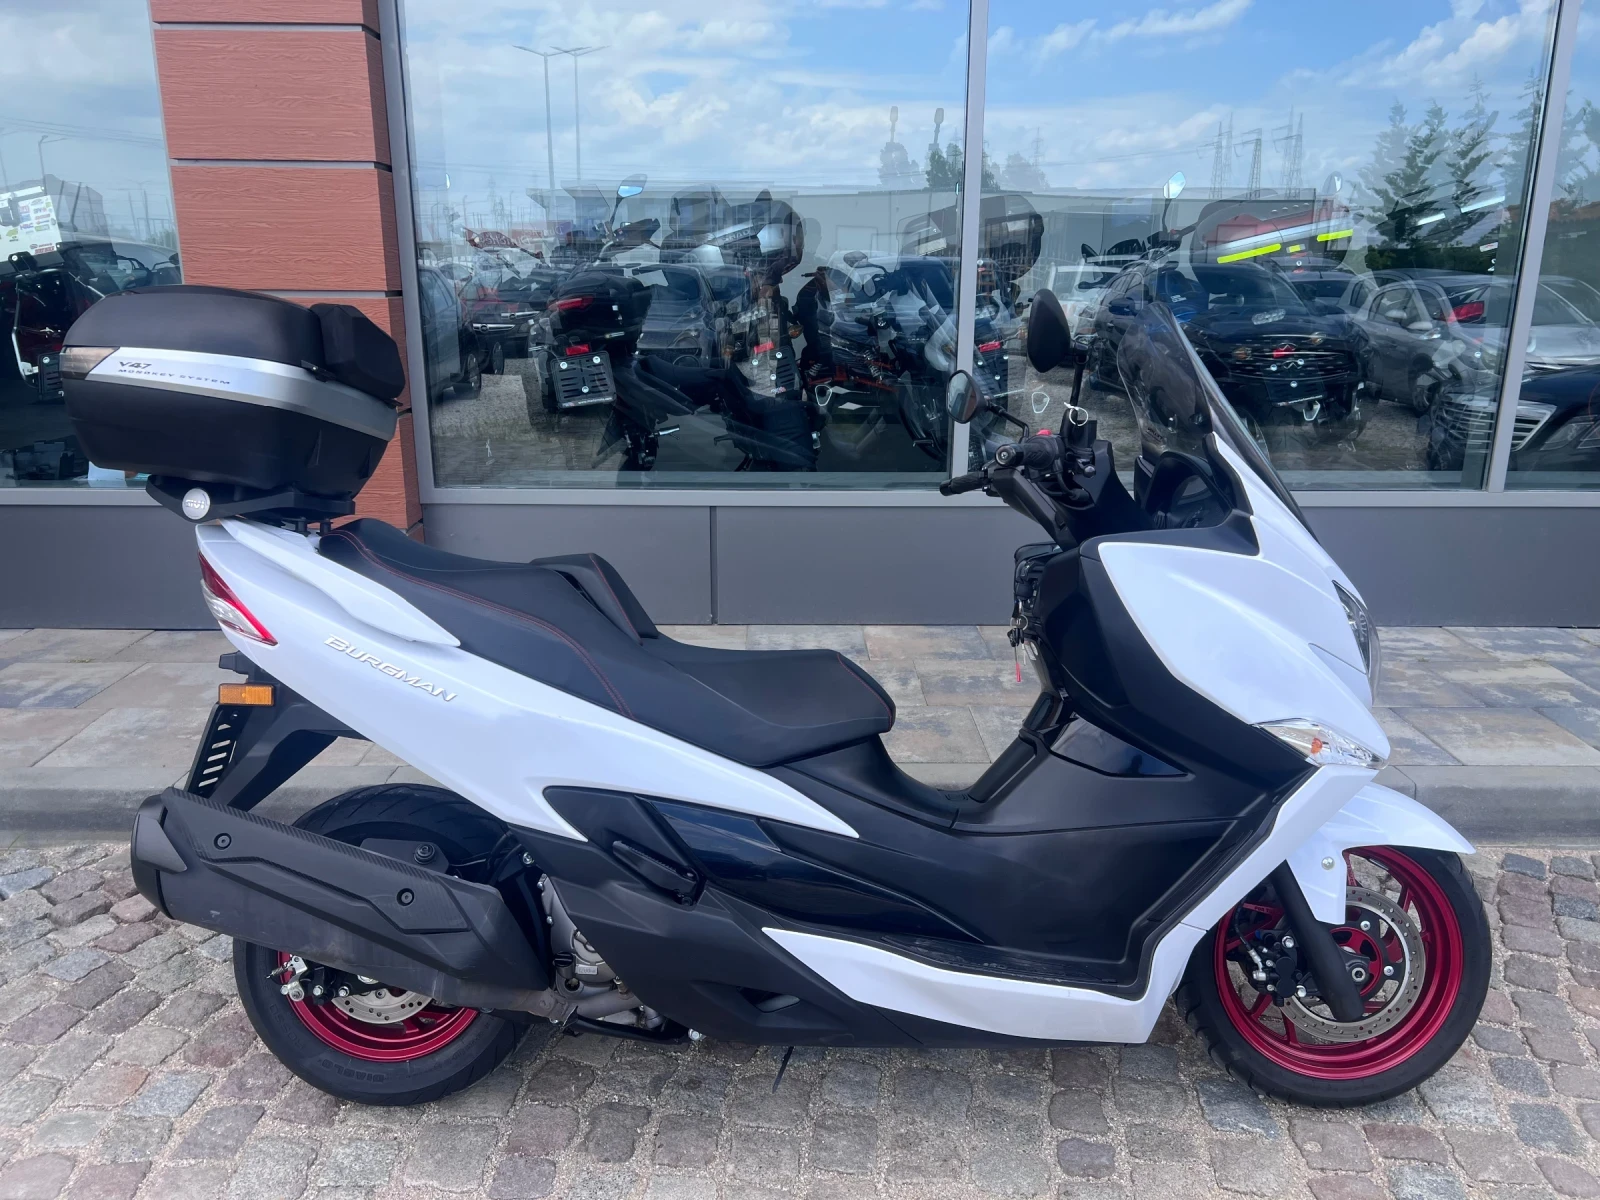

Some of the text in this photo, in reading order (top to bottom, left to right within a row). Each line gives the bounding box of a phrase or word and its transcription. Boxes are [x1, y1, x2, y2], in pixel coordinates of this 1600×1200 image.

[119, 361, 152, 370] V47
[180, 374, 231, 385] SYSTEM
[324, 633, 458, 702] BURGMAN
[321, 1059, 385, 1083] DIABLO
